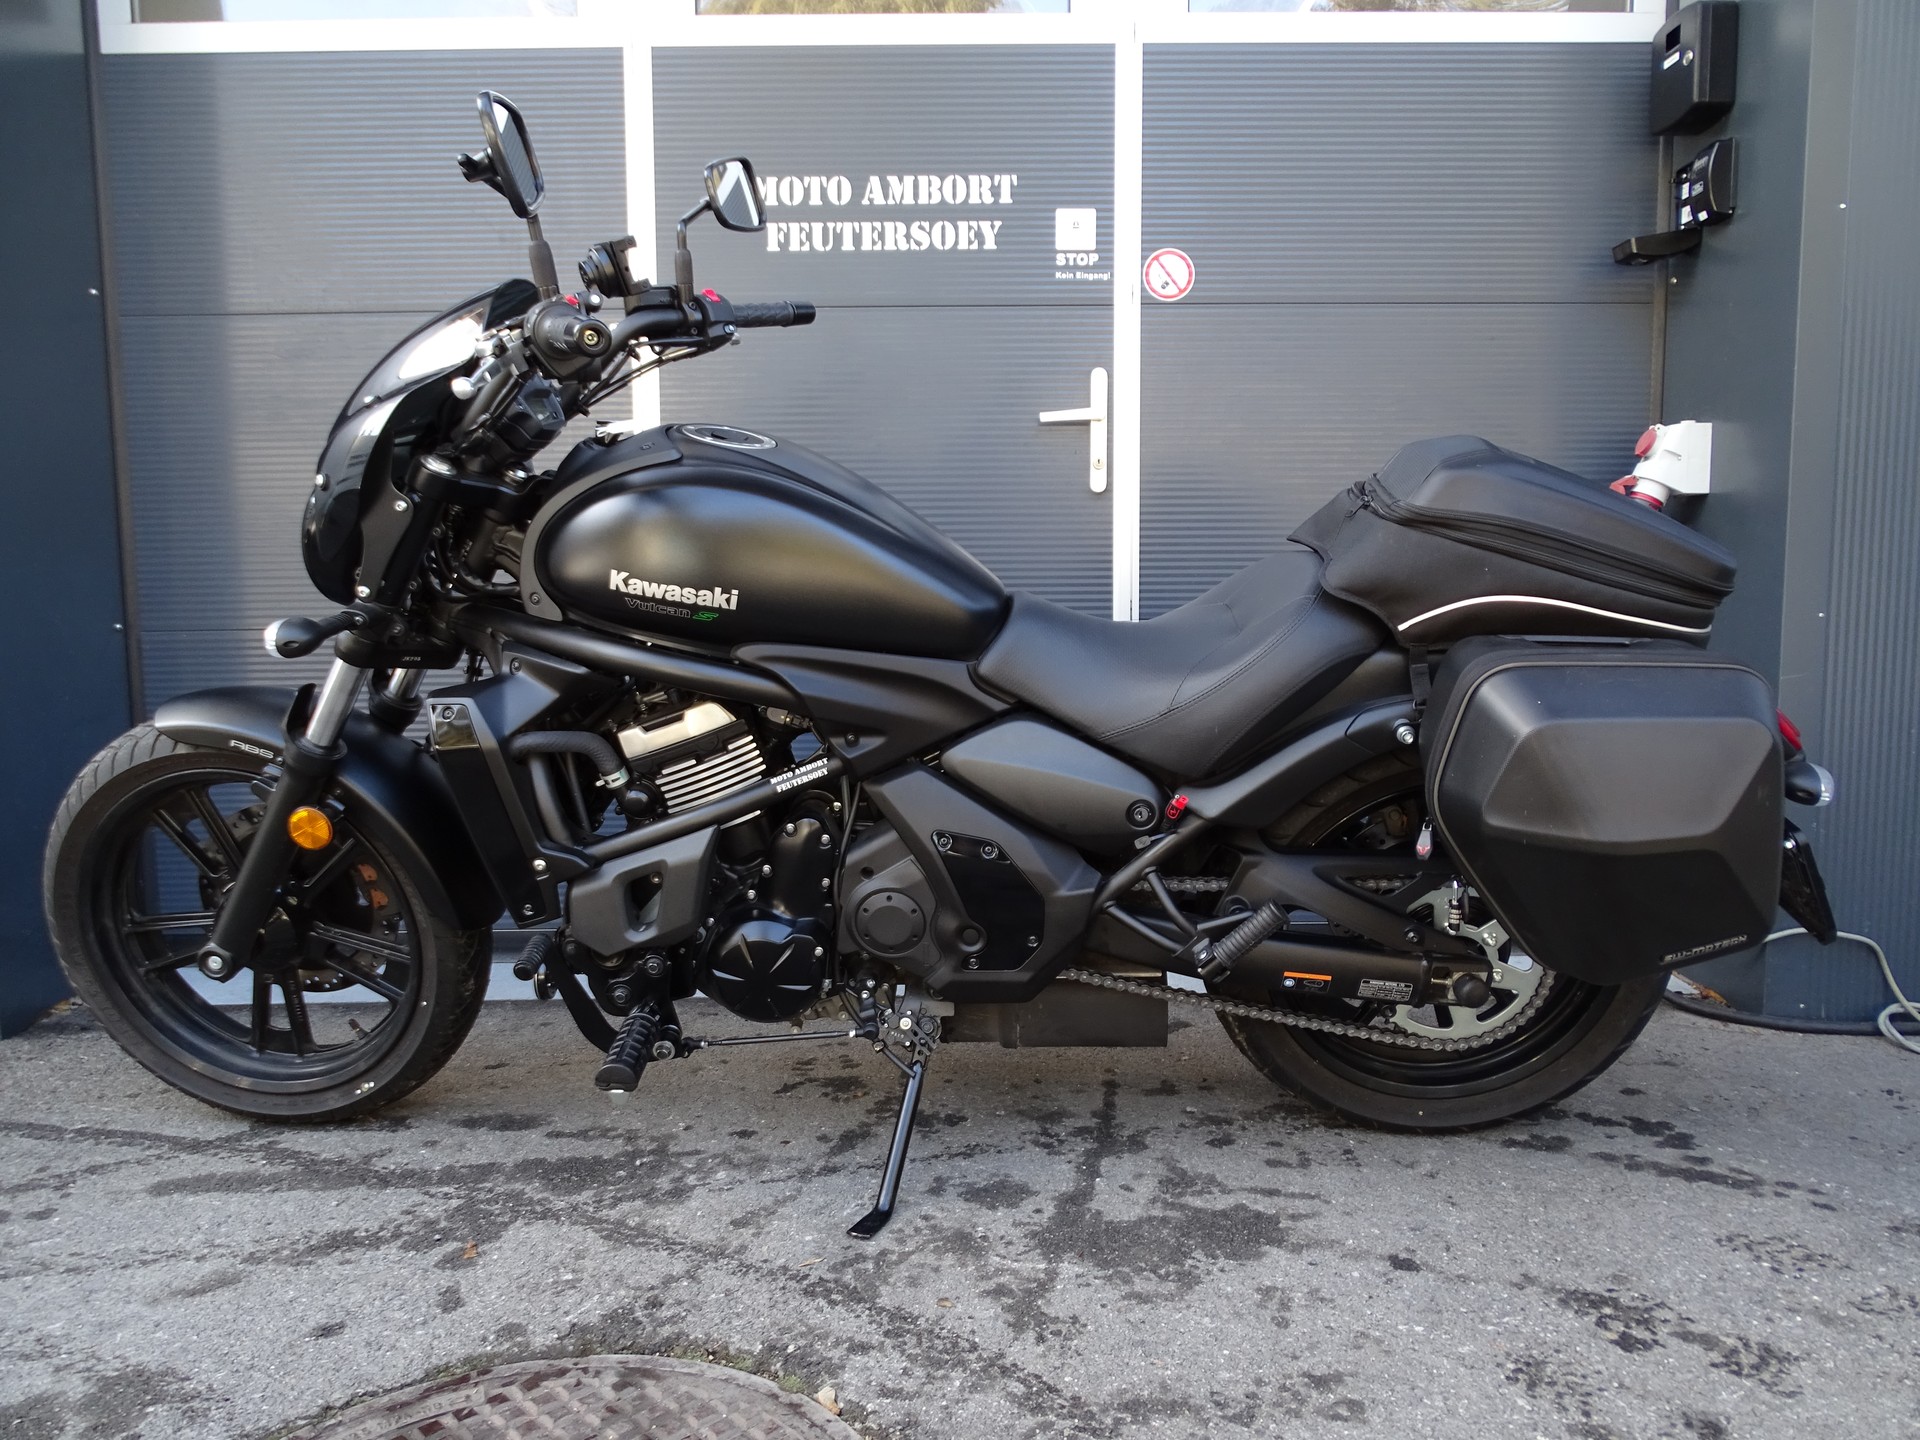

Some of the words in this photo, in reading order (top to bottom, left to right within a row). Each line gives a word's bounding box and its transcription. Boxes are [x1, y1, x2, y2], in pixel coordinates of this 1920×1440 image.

[756, 175, 852, 206] MOTO
[861, 174, 1018, 205] AMBORT
[766, 220, 1003, 251] FEUTERSOEY
[1055, 252, 1100, 267] STOP
[1055, 271, 1074, 279] Kein
[1075, 271, 1111, 281] Eingang!
[609, 568, 739, 611] Kawasaki
[625, 597, 691, 618] Vulcan
[692, 611, 719, 622] S
[230, 739, 275, 759] ABS
[770, 771, 793, 784] MOTO
[795, 758, 828, 775] AMBORT
[776, 767, 828, 793] FEUTERSOEY
